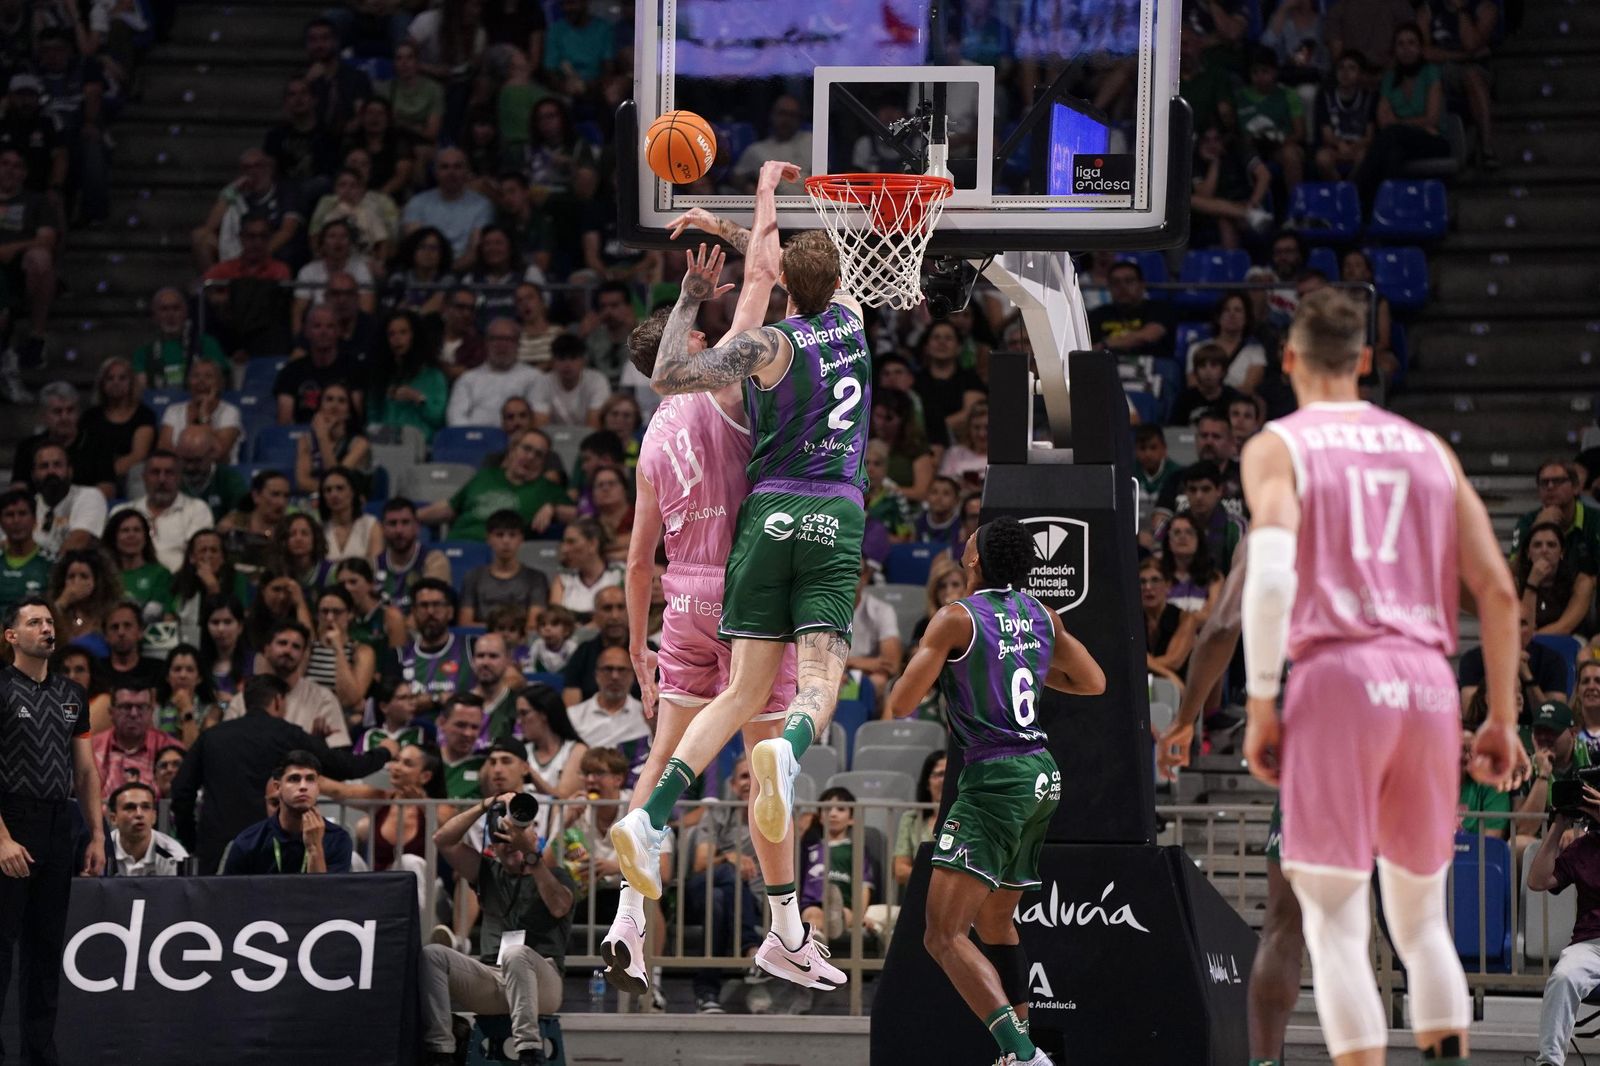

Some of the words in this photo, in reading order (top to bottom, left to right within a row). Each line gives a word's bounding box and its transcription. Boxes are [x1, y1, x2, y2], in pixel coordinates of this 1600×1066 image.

[1075, 165, 1101, 180] liga
[1075, 178, 1130, 191] endesa
[827, 376, 862, 431] 2
[662, 427, 703, 498] 13
[1345, 464, 1411, 563] 17
[817, 524, 837, 539] SOL
[1028, 577, 1068, 590] Unicaja
[670, 593, 692, 614] vdf
[693, 596, 723, 618] tea
[1011, 667, 1035, 728] 6
[62, 899, 377, 993] desa
[1035, 999, 1077, 1010] Andalucía
